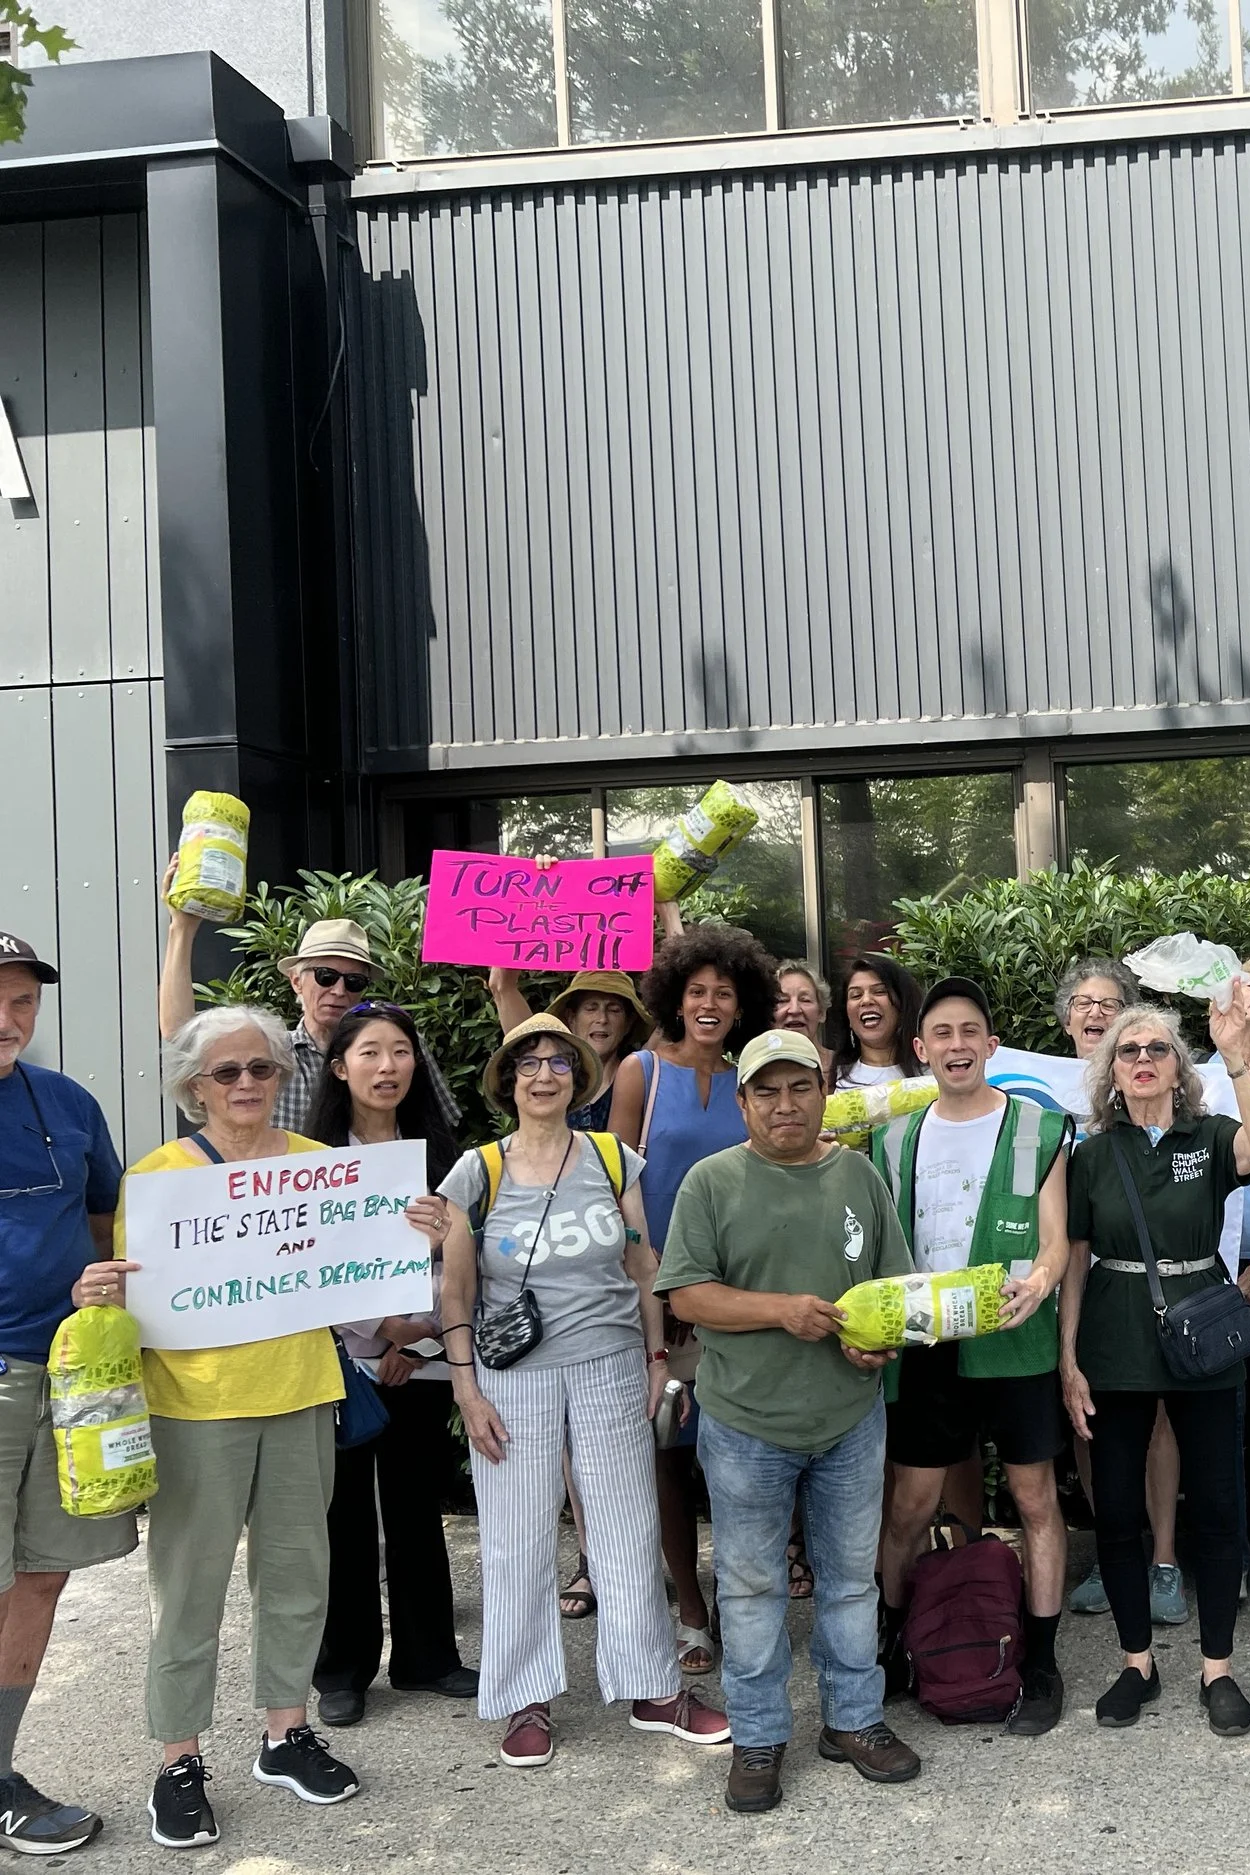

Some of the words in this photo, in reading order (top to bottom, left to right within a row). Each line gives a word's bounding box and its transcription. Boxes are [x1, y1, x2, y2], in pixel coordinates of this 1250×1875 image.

[445, 860, 563, 898] TURN
[587, 871, 654, 898] OFF
[508, 900, 567, 912] THE
[456, 907, 634, 935] PLASTIC
[1172, 1152, 1210, 1168] CHURCH
[1173, 1147, 1207, 1160] TRINITY
[1172, 1165, 1197, 1175] WALL
[1174, 1169, 1204, 1183] STREET
[227, 1159, 361, 1200] ENFORCE
[170, 1213, 230, 1250] THE
[236, 1203, 308, 1239] STATE
[319, 1199, 357, 1225] BAG
[363, 1194, 411, 1218] BAN
[511, 1204, 622, 1266] 350
[276, 1237, 317, 1257] AND
[108, 1436, 136, 1449] WHOLE
